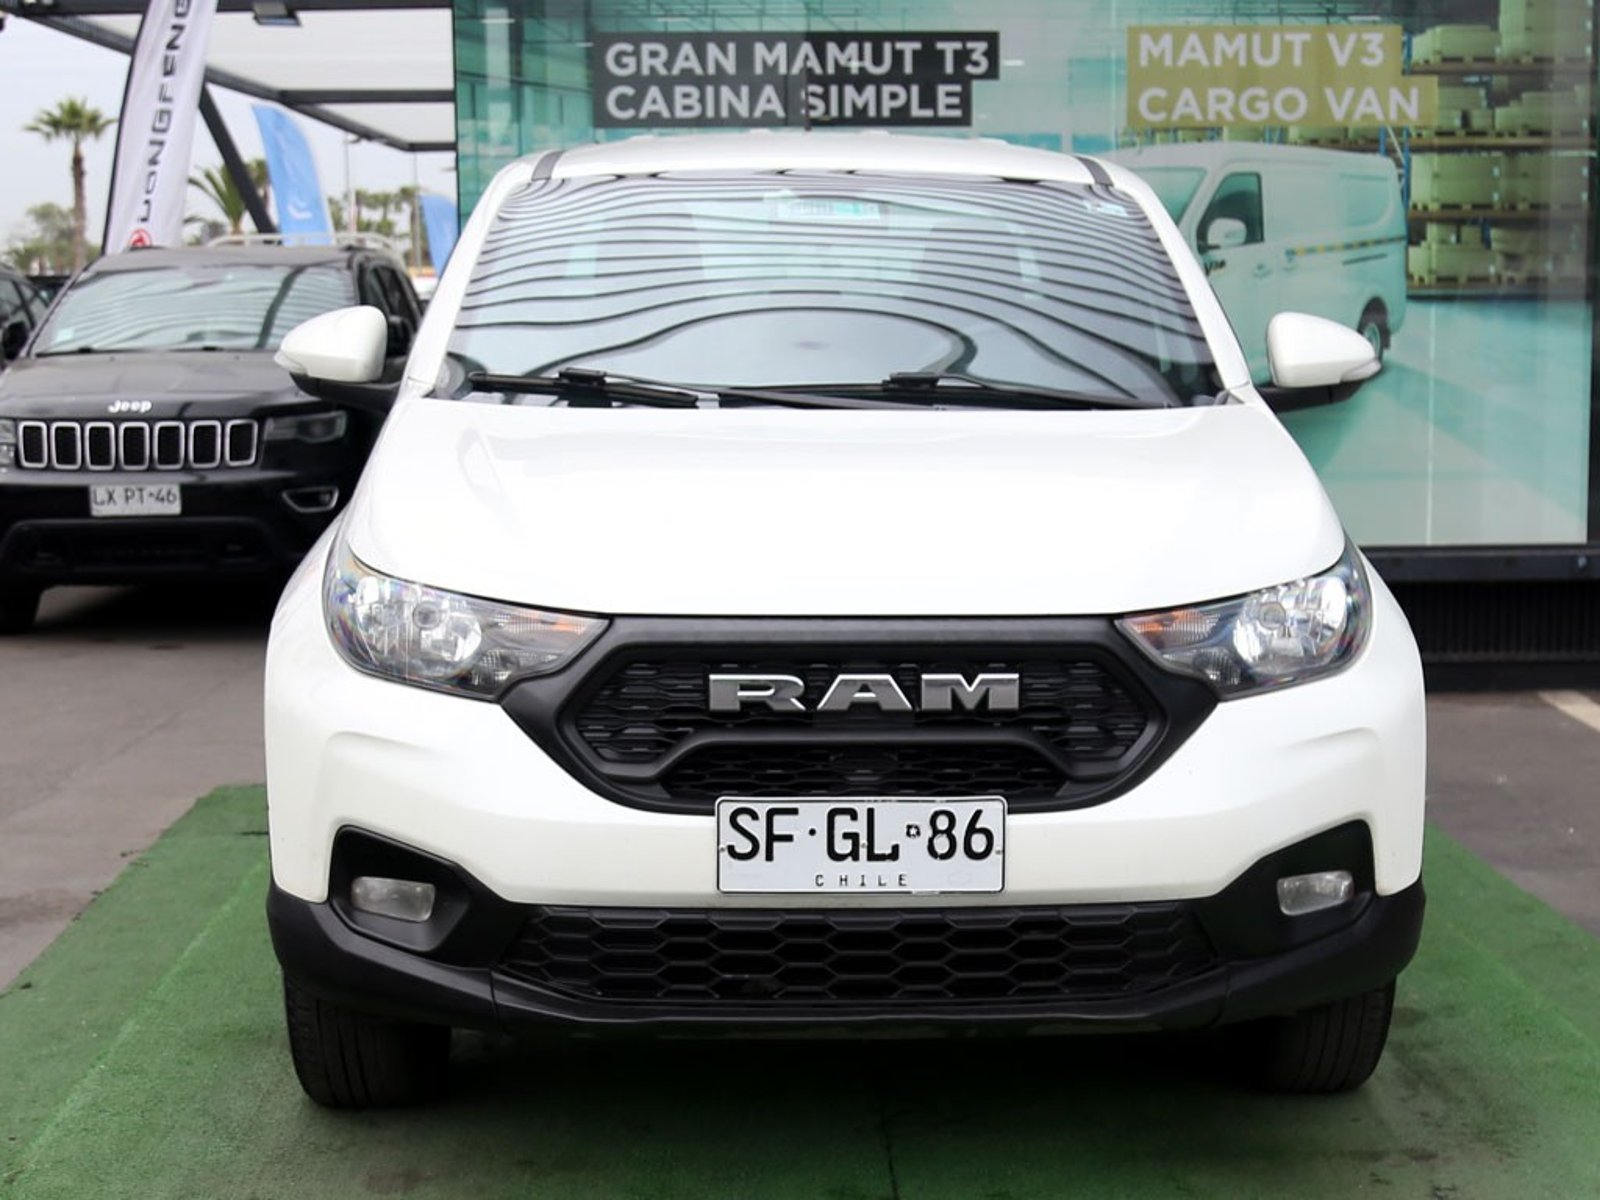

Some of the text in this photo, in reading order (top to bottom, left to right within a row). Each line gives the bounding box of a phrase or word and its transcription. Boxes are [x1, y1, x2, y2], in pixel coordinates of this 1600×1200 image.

[605, 41, 990, 76] GRAN MAMUT T3
[1138, 32, 1385, 67] MAMUT V3
[606, 85, 963, 119] CABINA SIMPLE
[1138, 87, 1420, 122] CARGO VAN
[108, 400, 152, 413] Jeep
[709, 674, 1019, 711] RAM
[815, 874, 908, 888] CHILE
